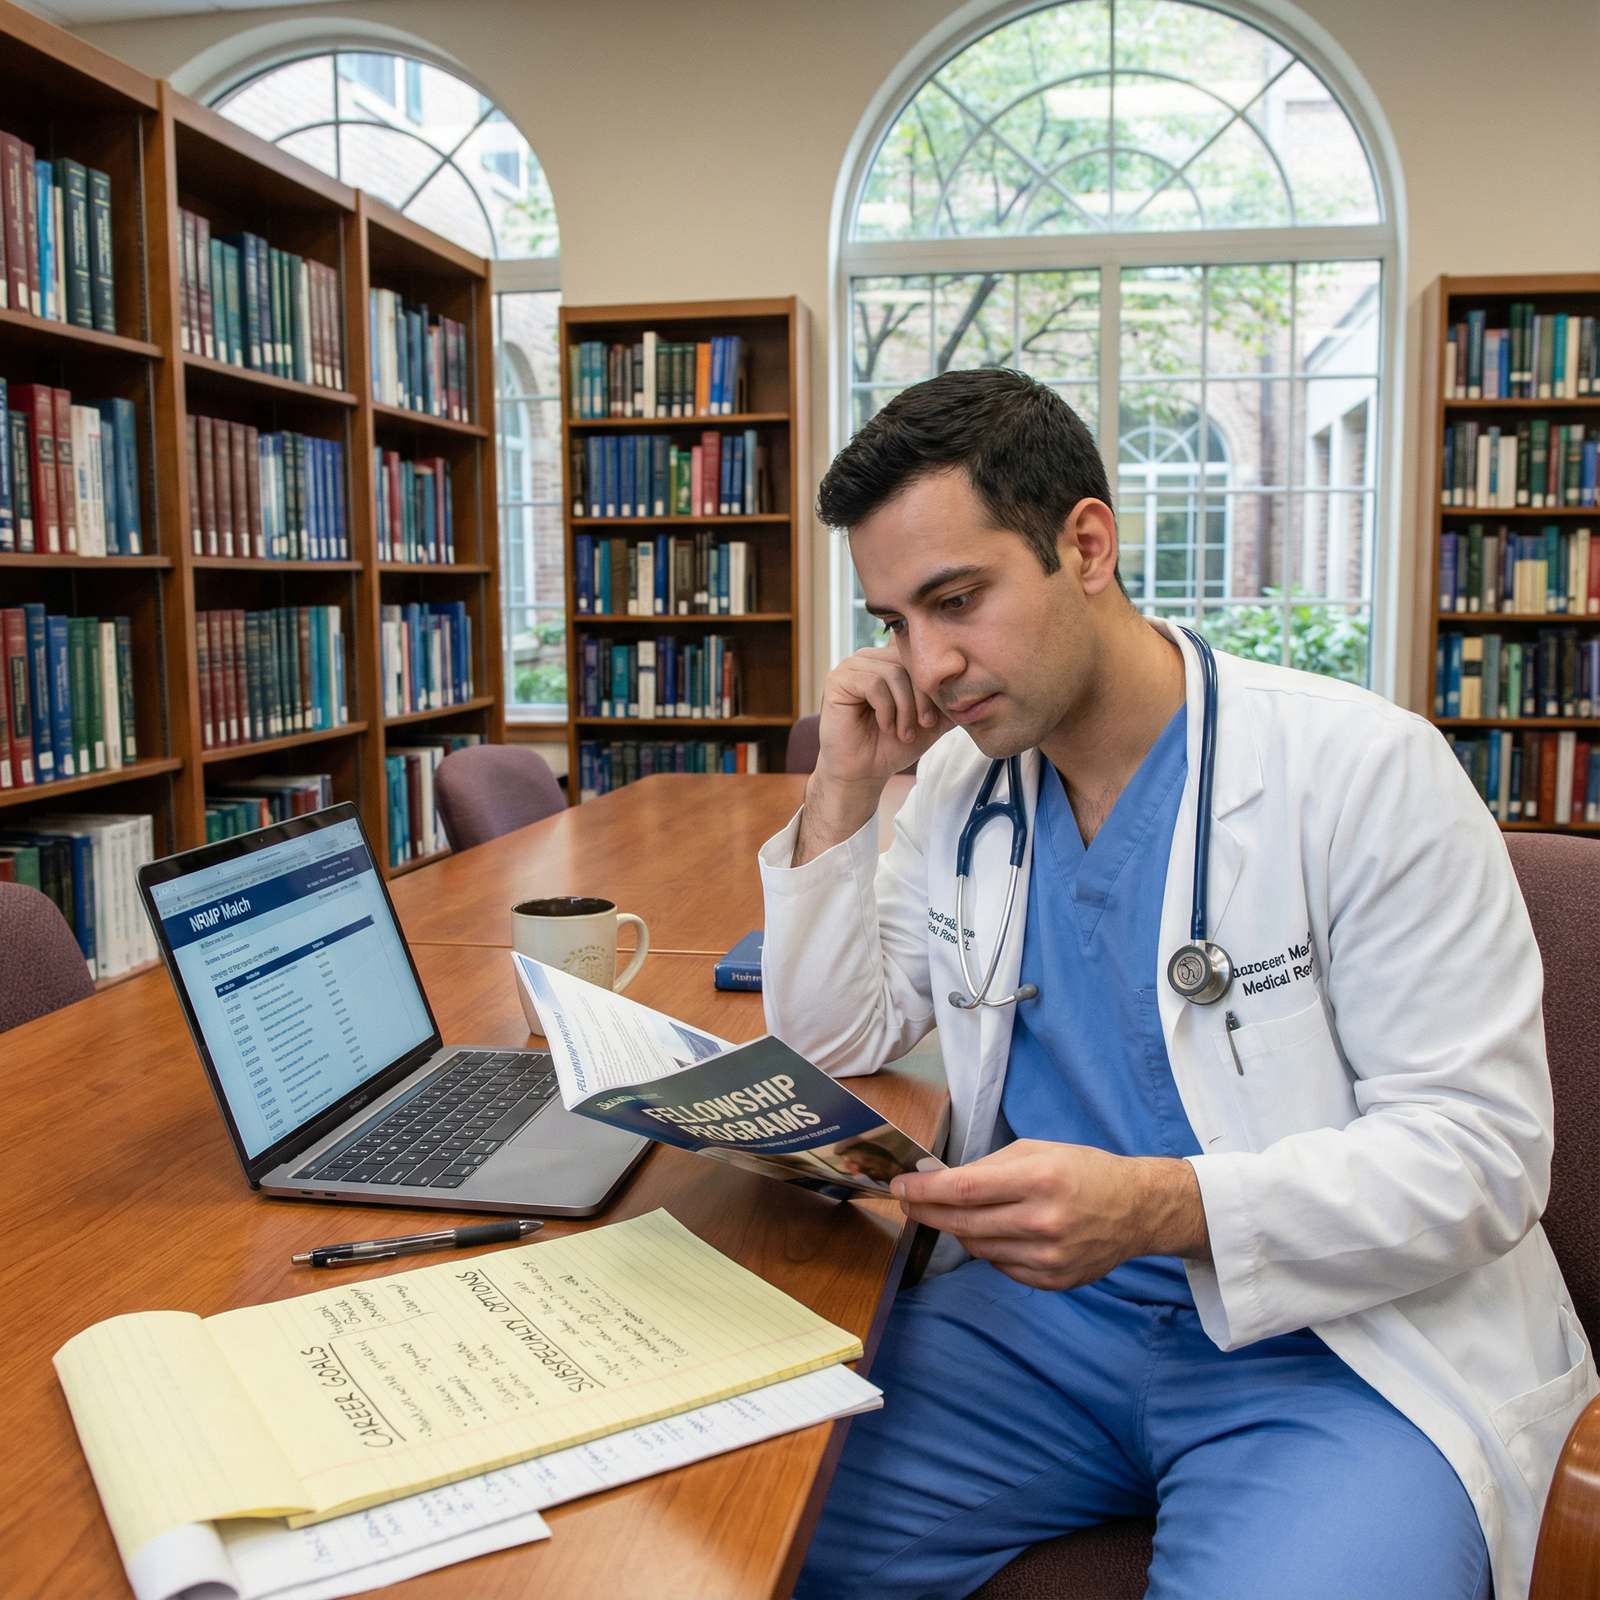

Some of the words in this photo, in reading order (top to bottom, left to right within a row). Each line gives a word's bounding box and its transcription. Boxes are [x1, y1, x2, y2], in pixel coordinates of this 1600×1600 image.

[189, 907, 220, 933] NRMP
[1242, 969, 1292, 997] Medical
[641, 1074, 796, 1124] FELLOWSHIP
[678, 1103, 821, 1142] PROGRAMS
[455, 1271, 510, 1313] OPTIONS
[300, 1345, 347, 1387] GOALS
[334, 1391, 394, 1448] CAREER
